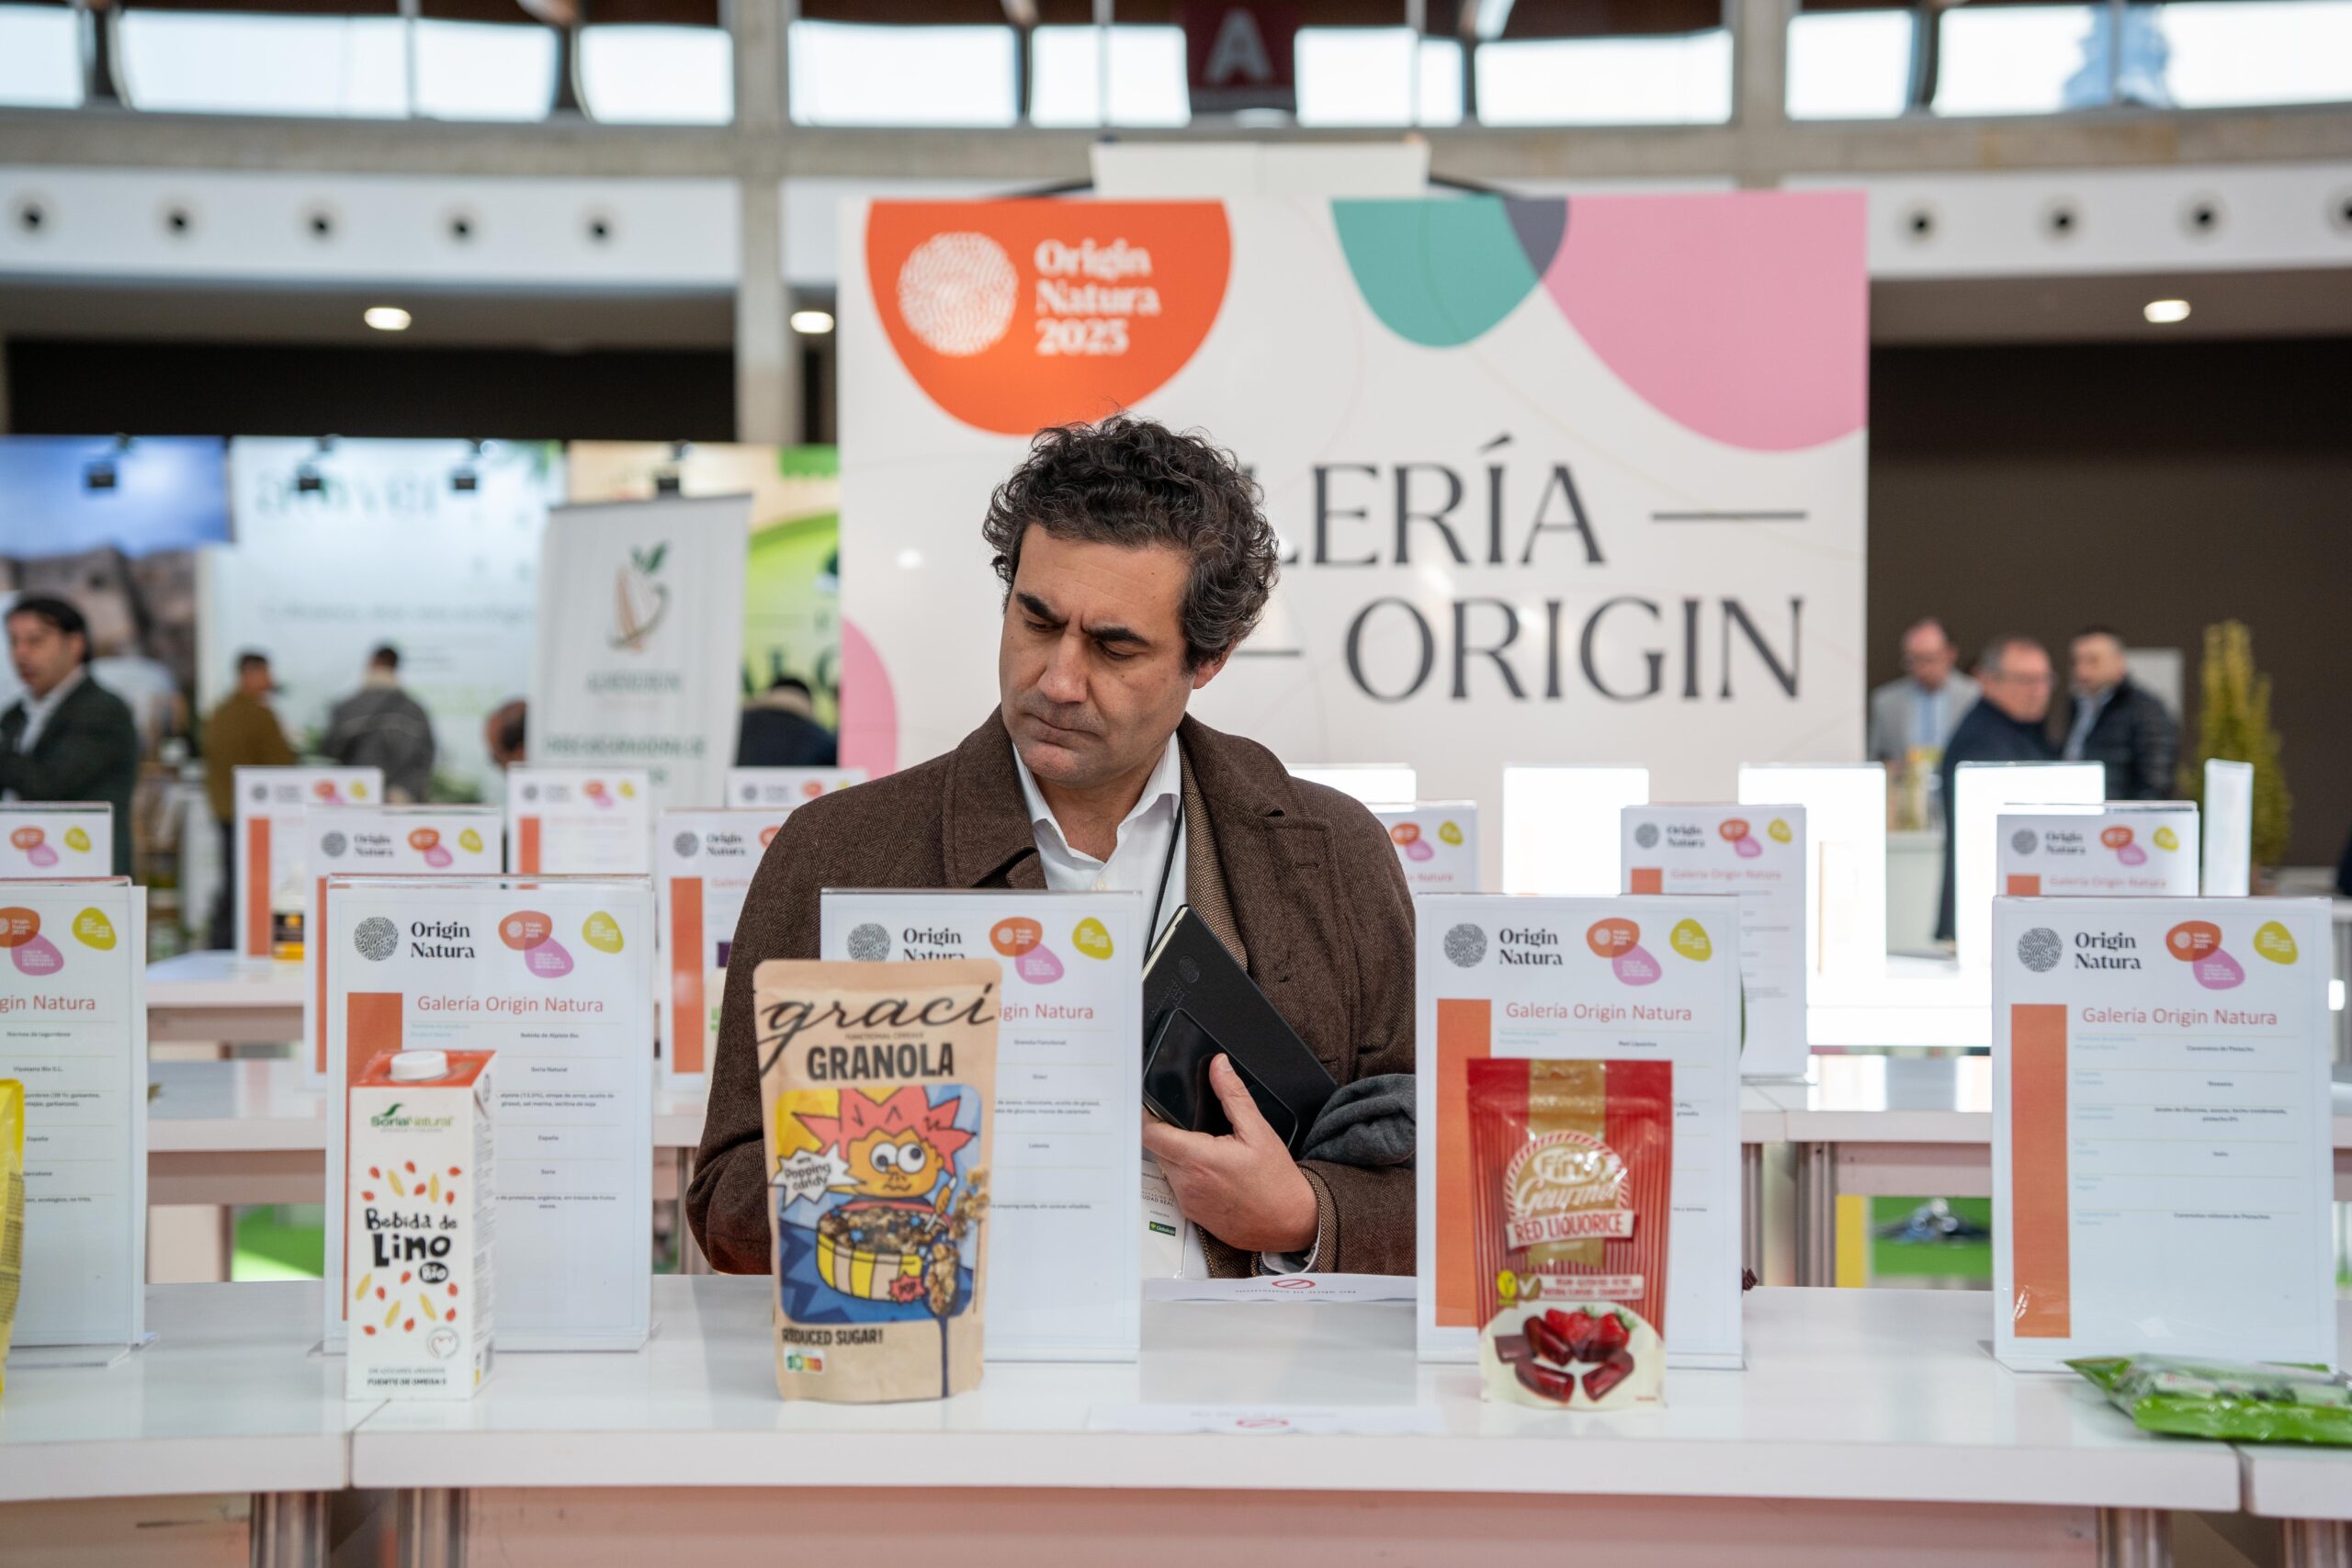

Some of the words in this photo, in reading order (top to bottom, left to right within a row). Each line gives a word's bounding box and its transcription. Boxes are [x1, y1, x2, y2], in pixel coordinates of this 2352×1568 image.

[1204, 7, 1273, 85] A
[1034, 237, 1153, 281] Origin
[1035, 278, 1161, 316] Natura
[1035, 318, 1130, 356] 2025
[1346, 596, 1804, 704] ORIGIN
[411, 920, 470, 941] Origin
[903, 927, 962, 947] Origin
[1499, 928, 1558, 948] Origin
[411, 942, 475, 959] Natura
[2075, 931, 2137, 952] Origin
[903, 948, 966, 962] Natura
[1499, 948, 1563, 965] Natura
[2075, 952, 2142, 970] Natura
[0, 995, 26, 1014] gin
[33, 995, 96, 1010] Natura
[418, 995, 480, 1011] Galería
[485, 996, 538, 1016] Origin
[546, 997, 604, 1012] Natura
[1035, 1004, 1094, 1020] Natura
[1506, 1001, 1568, 1020] Galería
[1573, 1003, 1627, 1023] Origin
[1633, 1005, 1692, 1021] Natura
[2082, 1007, 2147, 1023] Galería
[2152, 1008, 2209, 1028] Origin
[2214, 1009, 2278, 1026] Natura
[758, 983, 995, 1077] graci
[807, 1043, 955, 1080] GRANOLA
[365, 1208, 432, 1231] Bebida
[439, 1214, 458, 1230] de
[1515, 1221, 1544, 1242] RED
[1547, 1213, 1623, 1238] LIQUORICE
[372, 1232, 452, 1269] Lino
[898, 1280, 917, 1296] POP
[782, 1328, 832, 1346] REDUCED
[835, 1329, 884, 1346] SUGAR!
